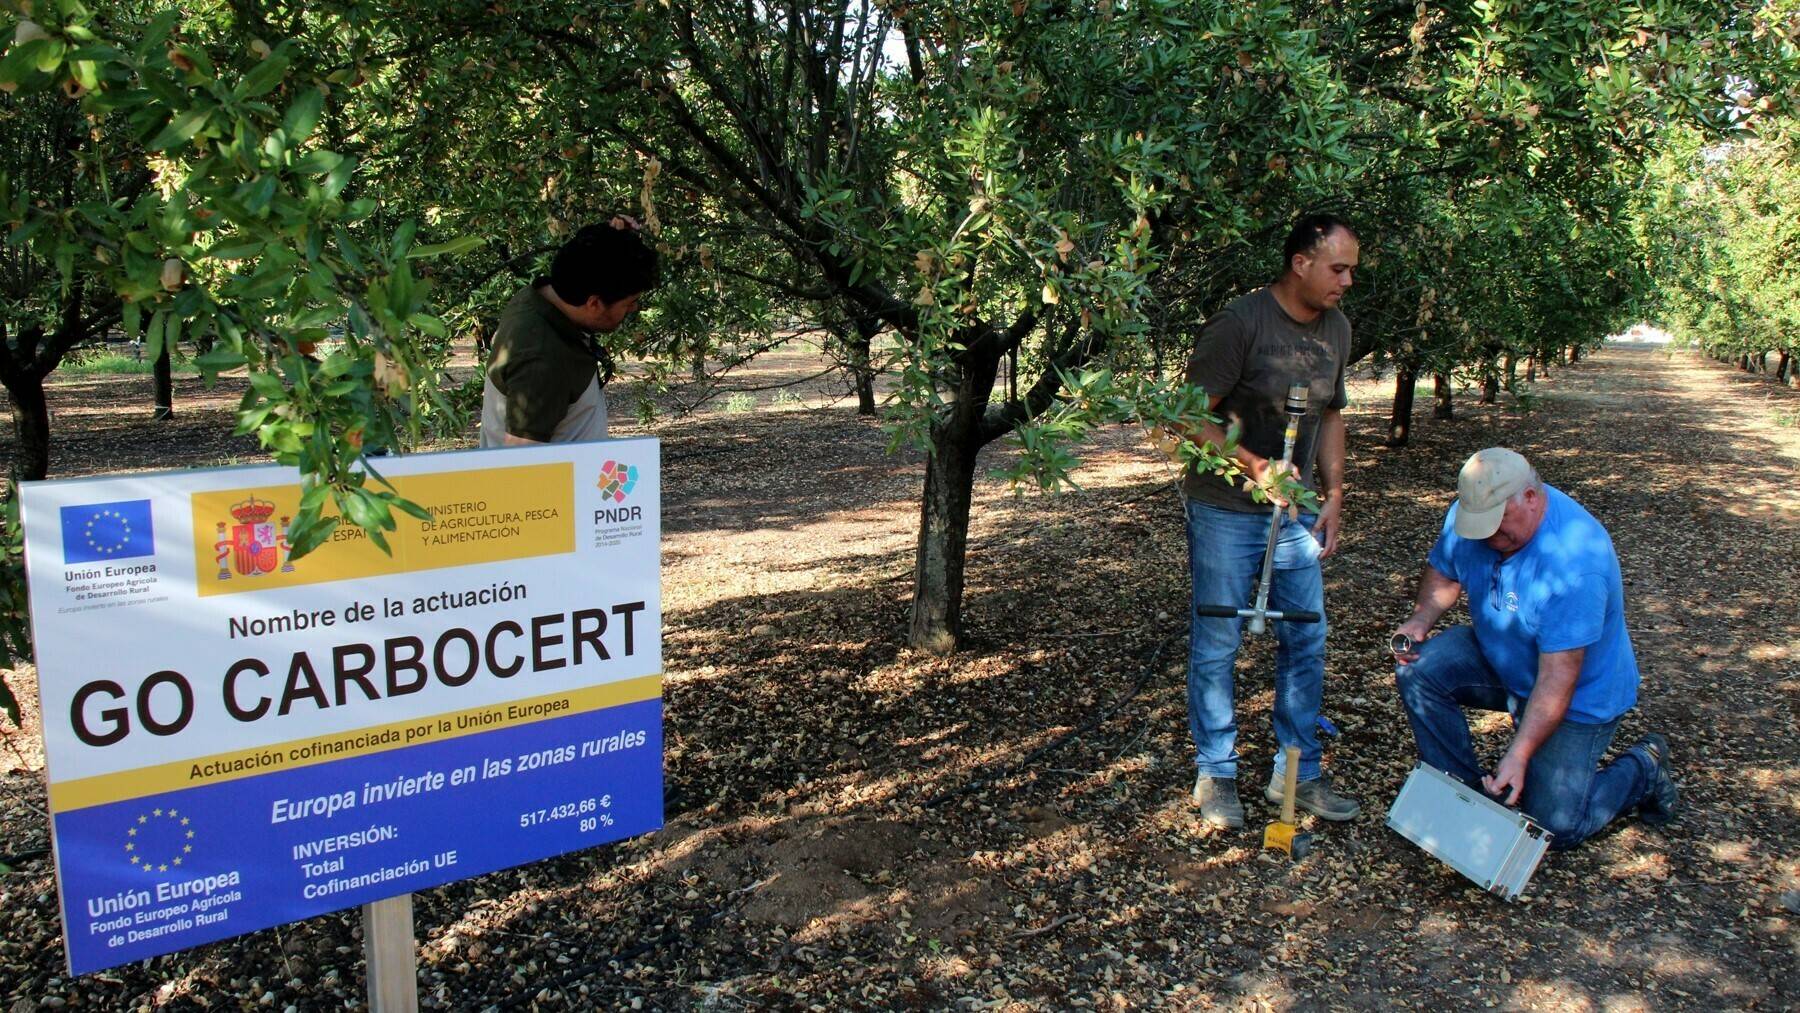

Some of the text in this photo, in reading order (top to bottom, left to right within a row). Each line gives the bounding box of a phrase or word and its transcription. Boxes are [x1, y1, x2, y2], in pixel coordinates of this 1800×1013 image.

[421, 521, 437, 532] DE
[525, 508, 559, 521] PESCA
[594, 505, 642, 525] PNDR
[421, 525, 520, 547] Y ALIMENTACIÓN
[65, 563, 157, 581] Unión Europea
[66, 584, 90, 593] Fondo
[92, 580, 124, 591] Europeo
[75, 585, 150, 601] de Desarrollo Rural
[228, 581, 527, 639] Nombre de la actuación
[69, 601, 646, 747] GO CARBOCERT
[189, 698, 570, 780] Actuación cofinanciada por la Unión Europea
[271, 729, 647, 824] Europa invierte en las zonas rurales
[519, 794, 612, 828] 517.432,66 €
[579, 813, 614, 833] 80 %
[293, 824, 399, 861] INVERSIÓN:
[302, 855, 345, 879] Total
[303, 849, 458, 900] Cofinanciación UE
[88, 870, 241, 918] Unión Europea
[90, 889, 242, 936] Fondo Europeo Agrícola
[107, 908, 229, 948] de Desarrollo Rural
